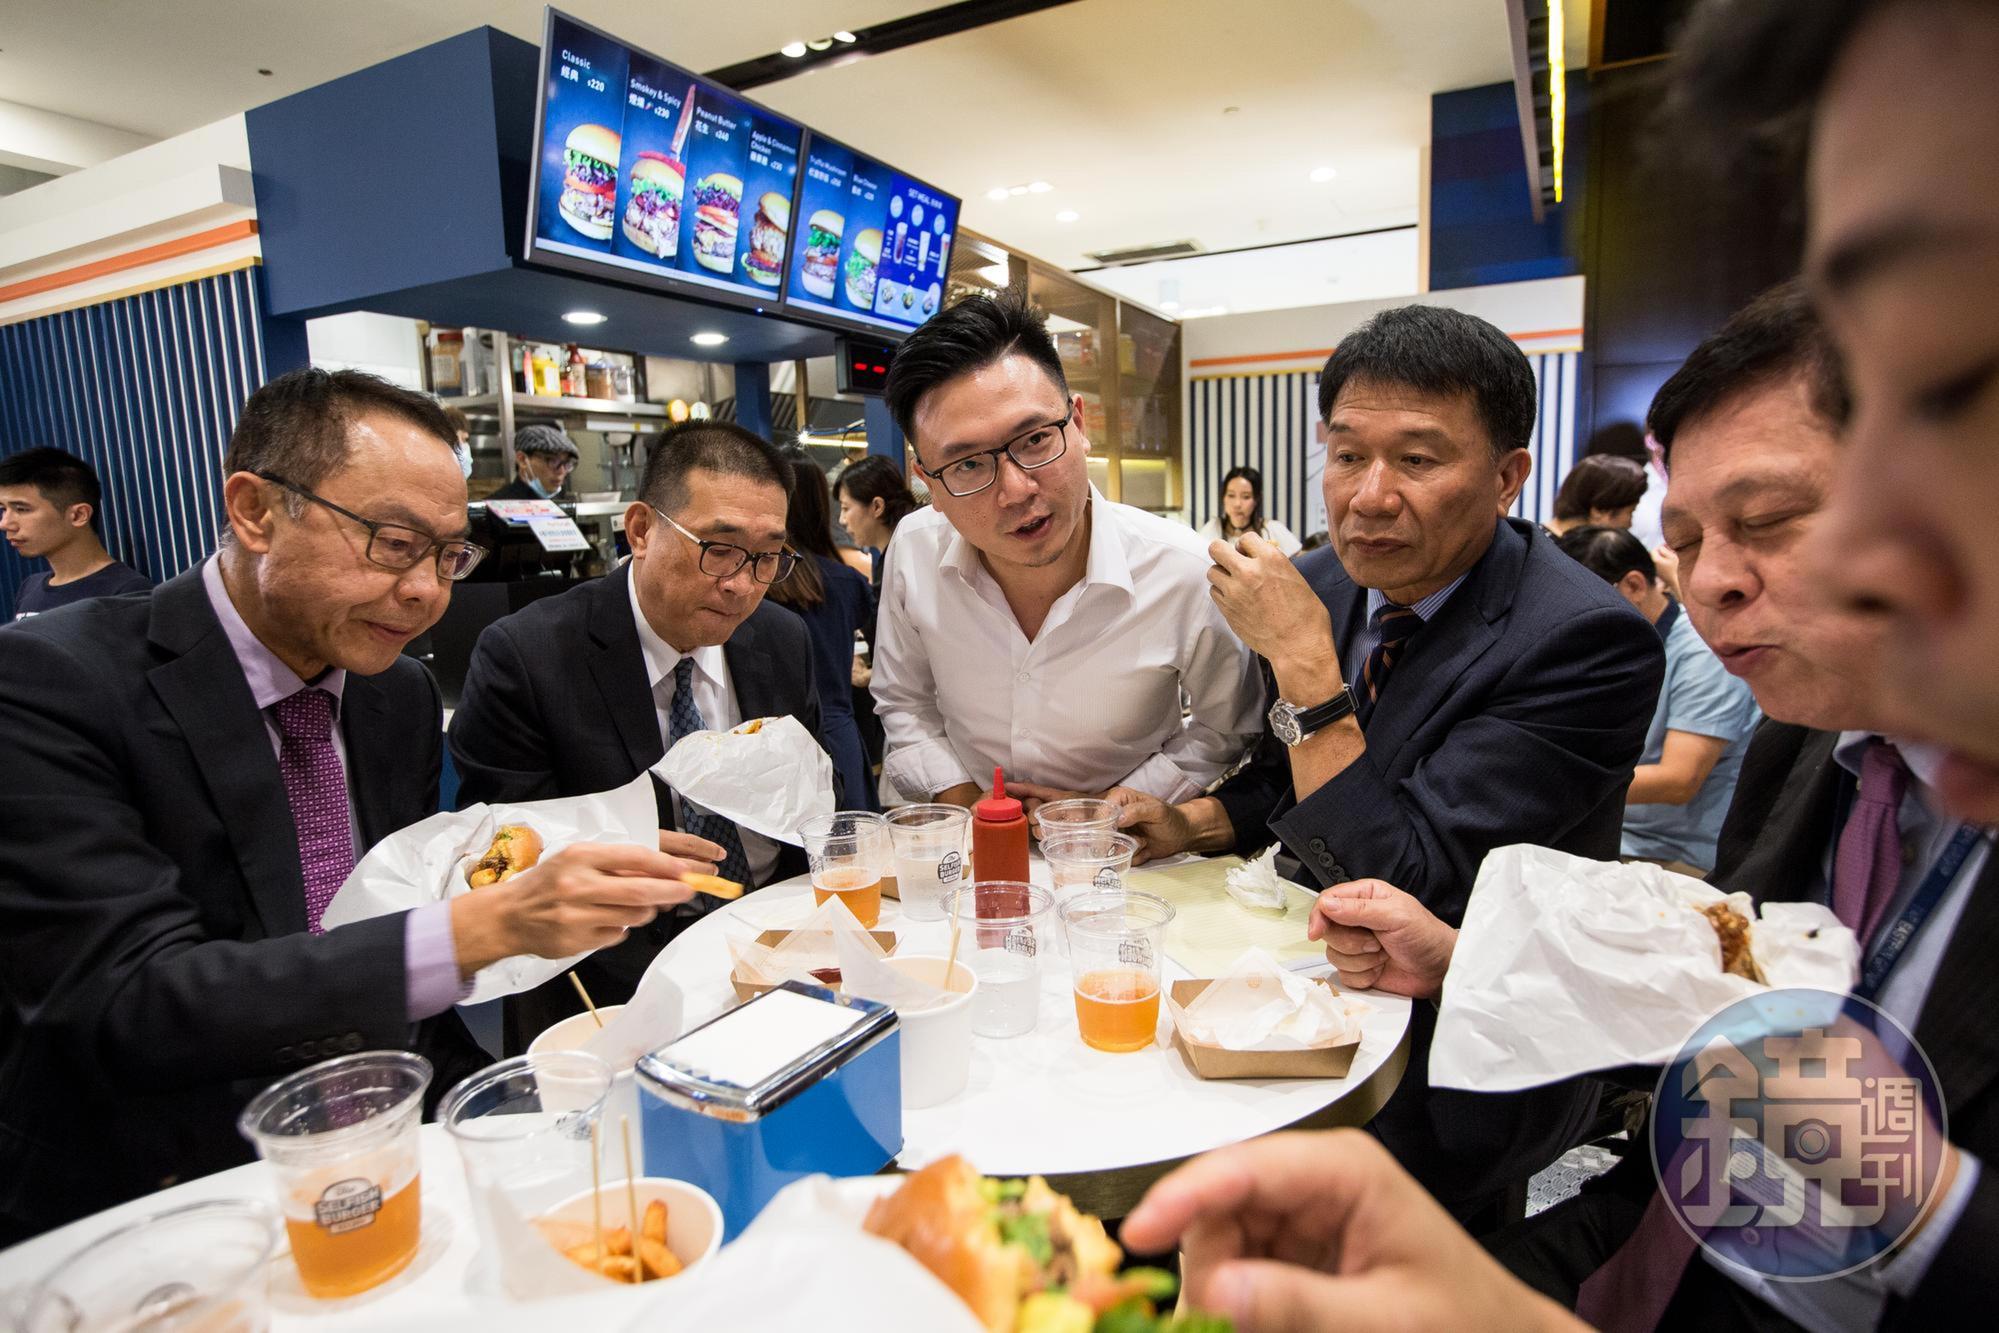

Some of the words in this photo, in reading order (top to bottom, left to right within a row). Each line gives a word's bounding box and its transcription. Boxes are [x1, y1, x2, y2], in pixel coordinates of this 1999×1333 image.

[561, 49, 591, 70] Classic
[587, 78, 605, 92] $220
[663, 92, 681, 109] Spicy
[696, 106, 718, 123] Peanut
[718, 115, 737, 130] Butter
[752, 130, 768, 144] Apple
[750, 140, 771, 155] Chicken
